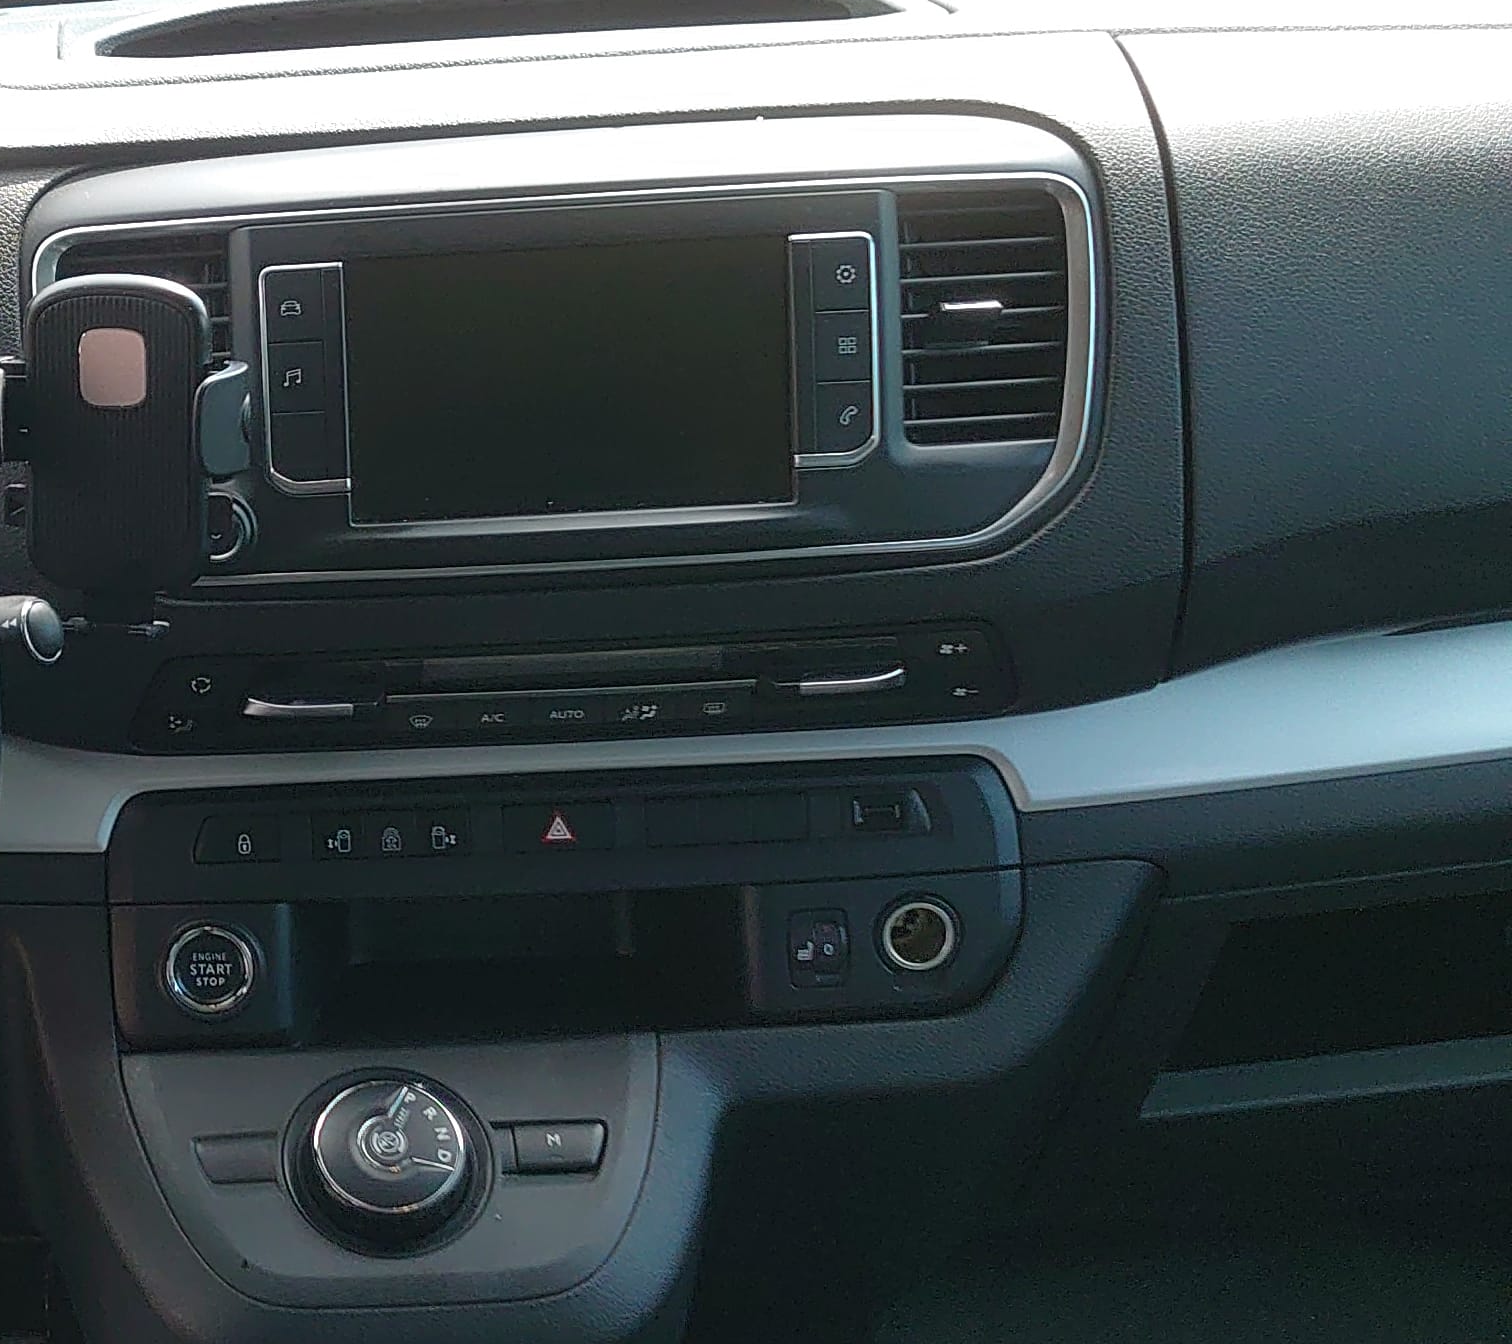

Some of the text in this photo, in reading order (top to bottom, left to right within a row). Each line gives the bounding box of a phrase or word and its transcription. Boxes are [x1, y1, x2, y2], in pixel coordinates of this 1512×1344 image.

[481, 713, 505, 723] A/C
[550, 710, 585, 719] AUTO
[192, 952, 226, 961] ENGINE
[189, 963, 232, 976] START
[196, 977, 225, 987] STOP
[404, 1091, 417, 1103] P
[422, 1106, 437, 1121] R
[434, 1127, 451, 1141] N
[437, 1148, 453, 1163] D
